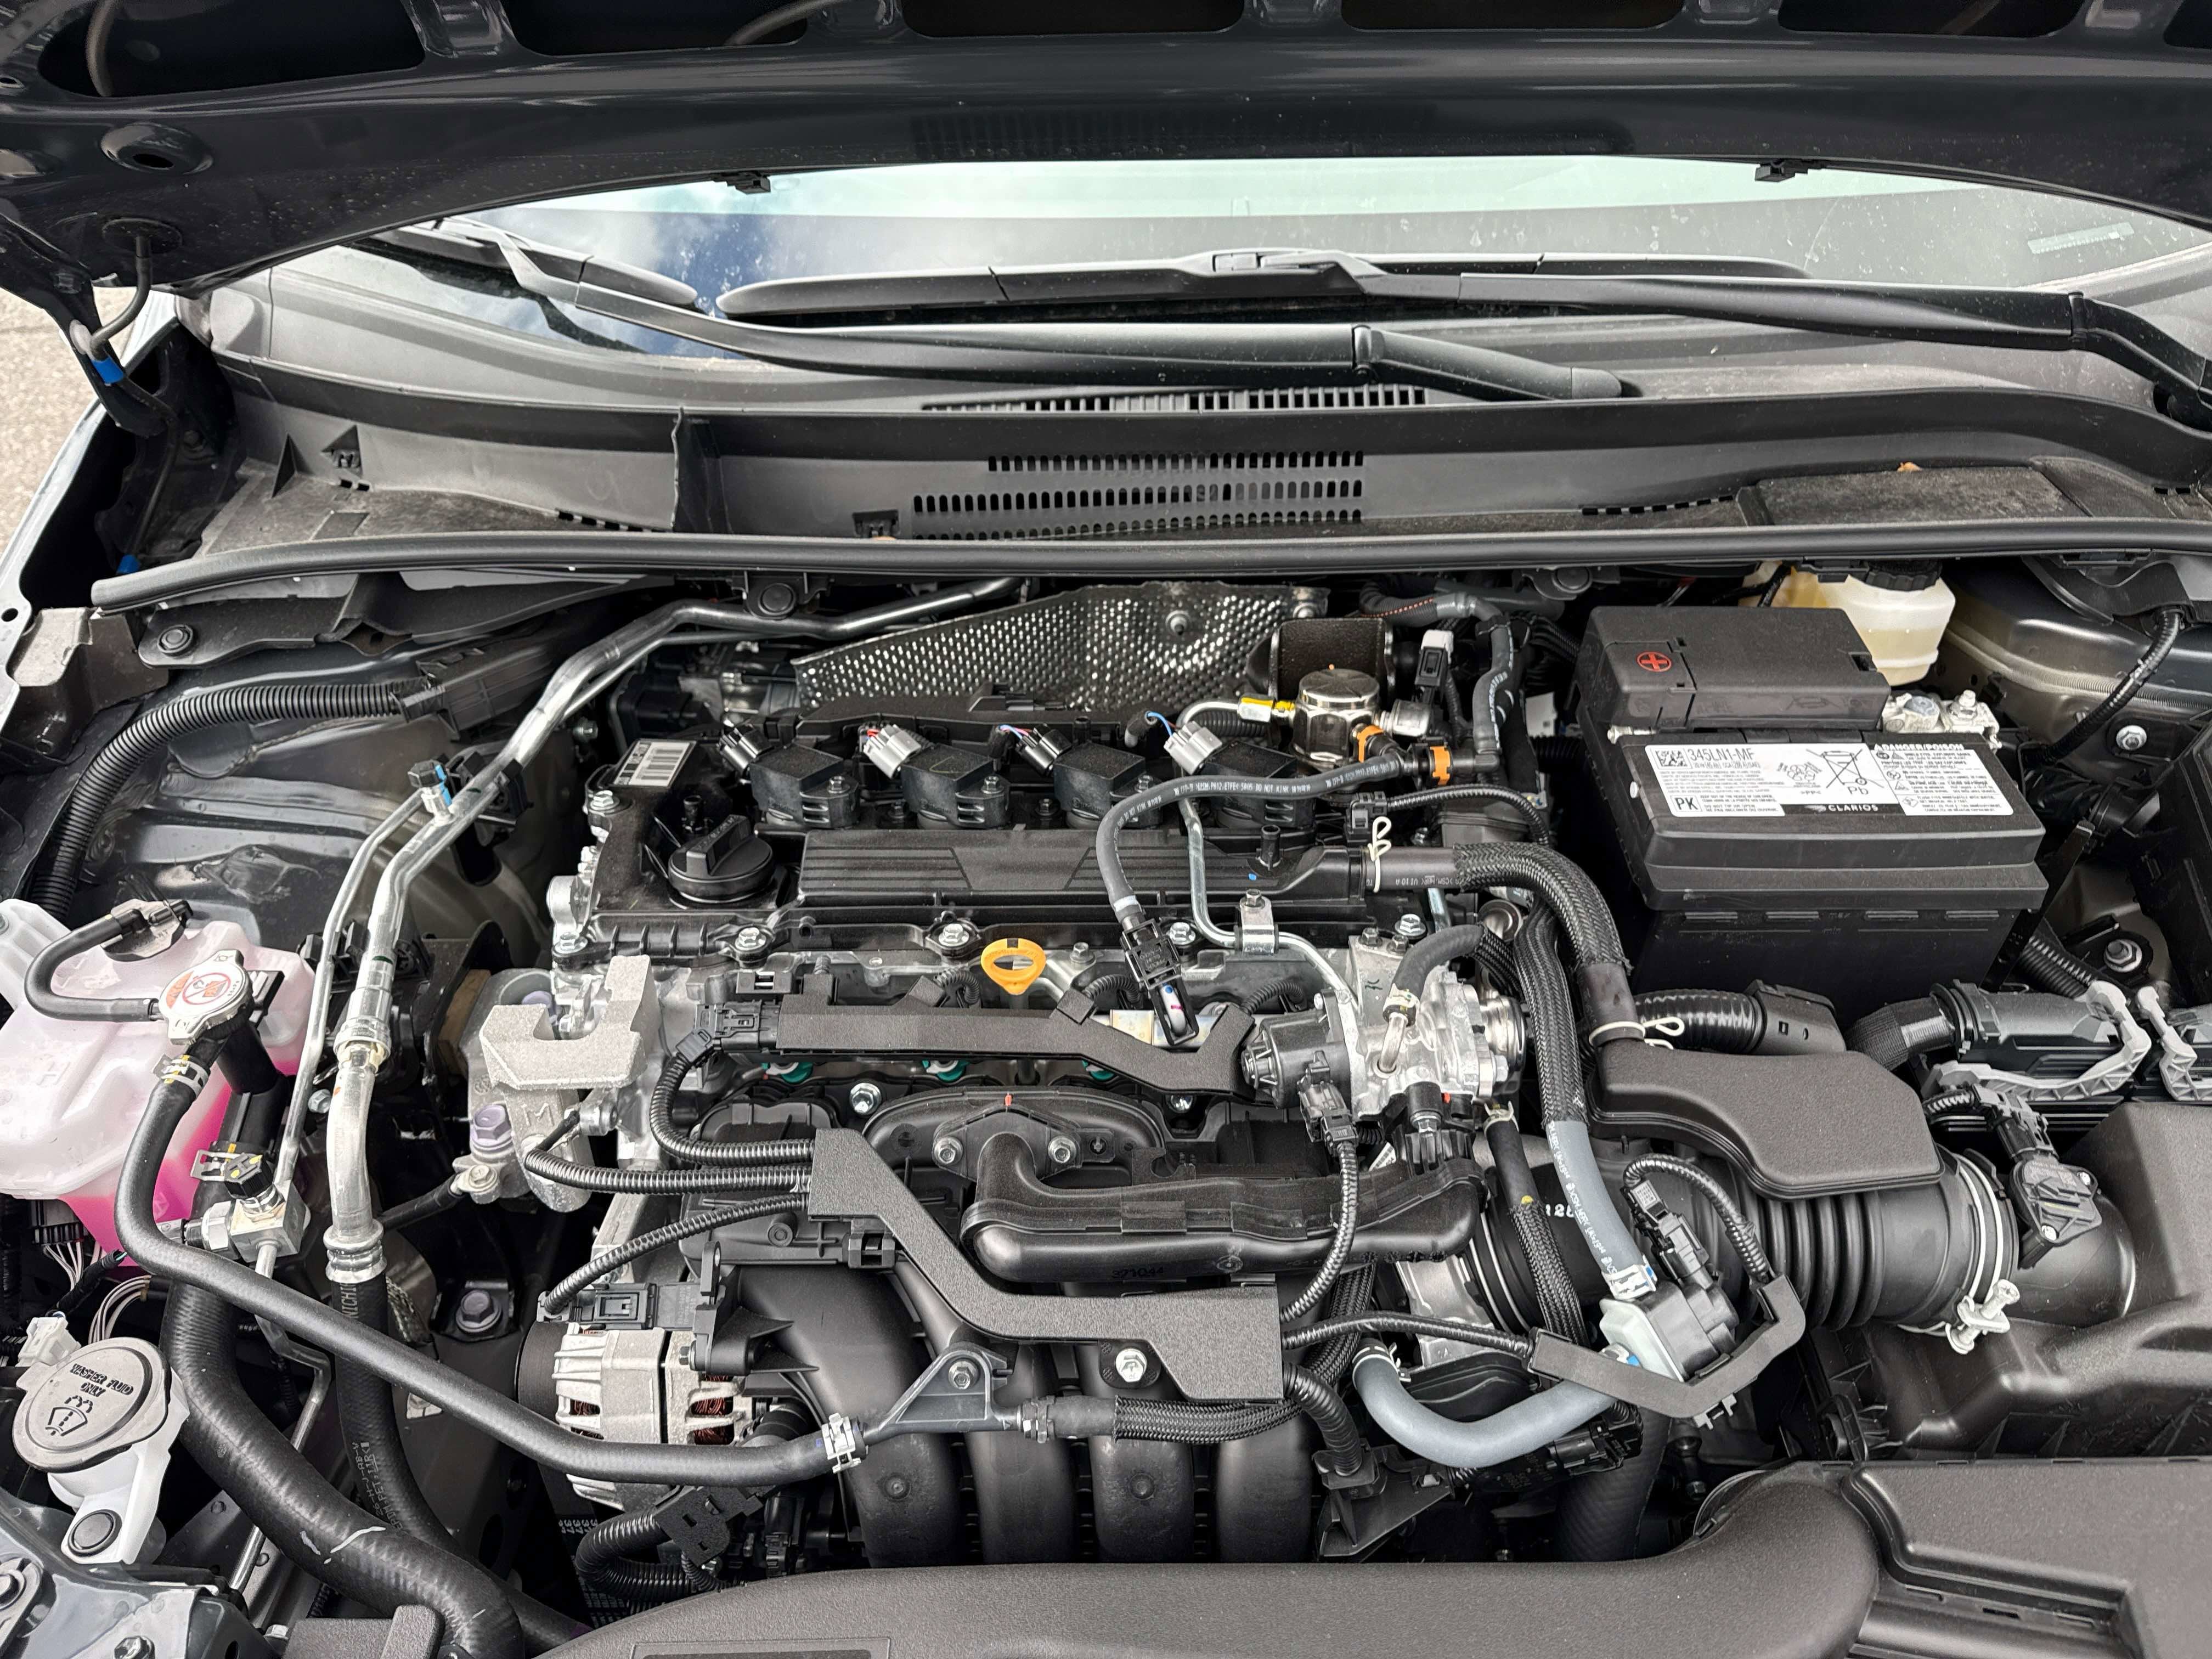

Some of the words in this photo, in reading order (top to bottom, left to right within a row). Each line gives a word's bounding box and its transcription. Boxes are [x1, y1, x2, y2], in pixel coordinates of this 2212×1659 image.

[1687, 748, 1754, 761] 345LN1-MF
[1847, 786, 1869, 795] Pb
[1674, 797, 1699, 810] PK
[69, 1363, 108, 1385] WASHER
[106, 1378, 134, 1396] FLUID
[80, 1381, 106, 1398] ONLY
